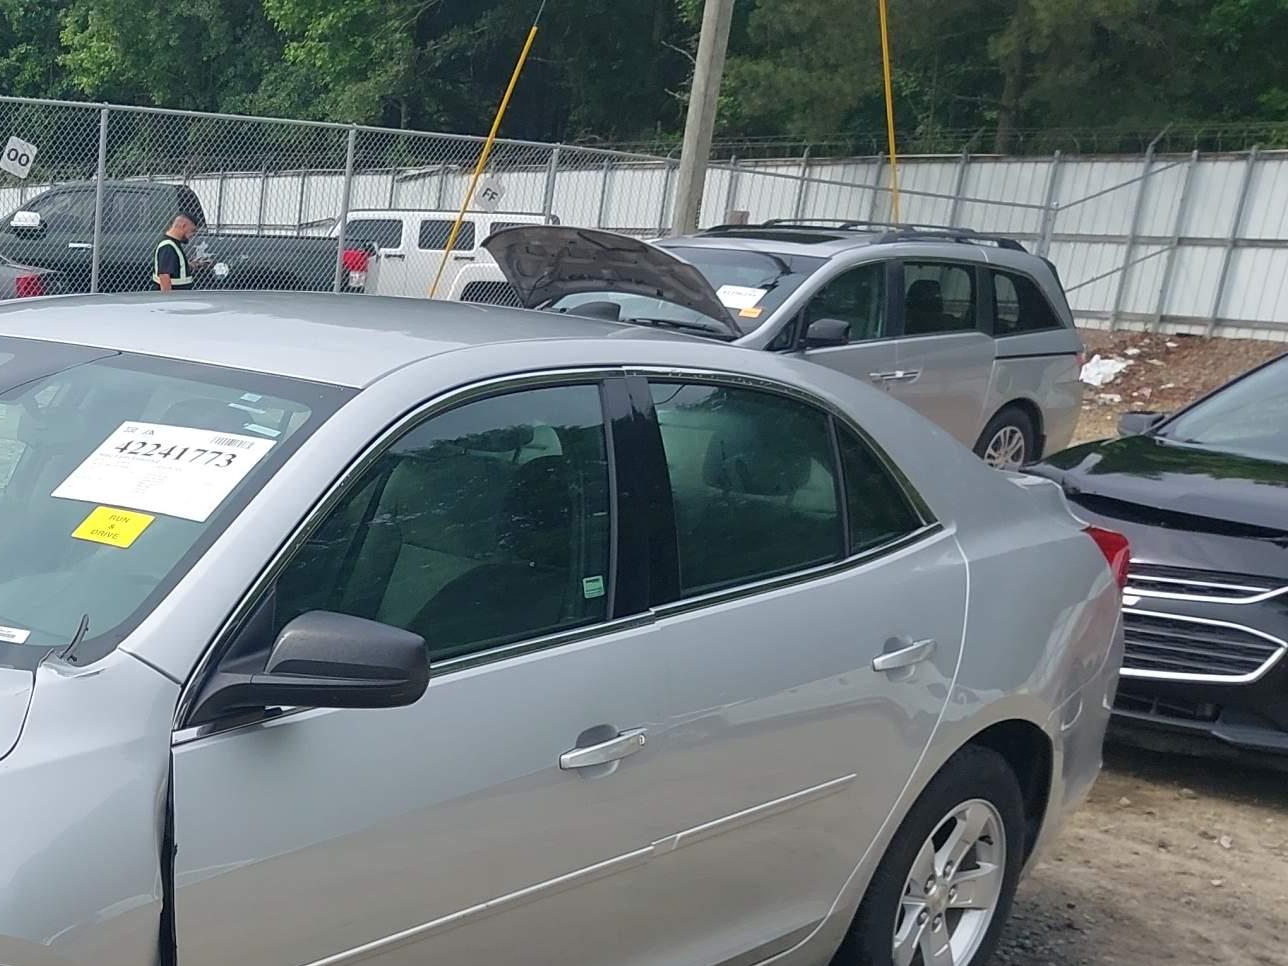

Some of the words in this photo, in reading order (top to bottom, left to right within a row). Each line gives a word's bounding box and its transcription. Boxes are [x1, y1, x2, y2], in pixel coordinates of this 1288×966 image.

[482, 187, 499, 201] FF
[115, 440, 238, 468] 42241773
[108, 514, 131, 524] RUN
[90, 529, 120, 540] DRIVE
